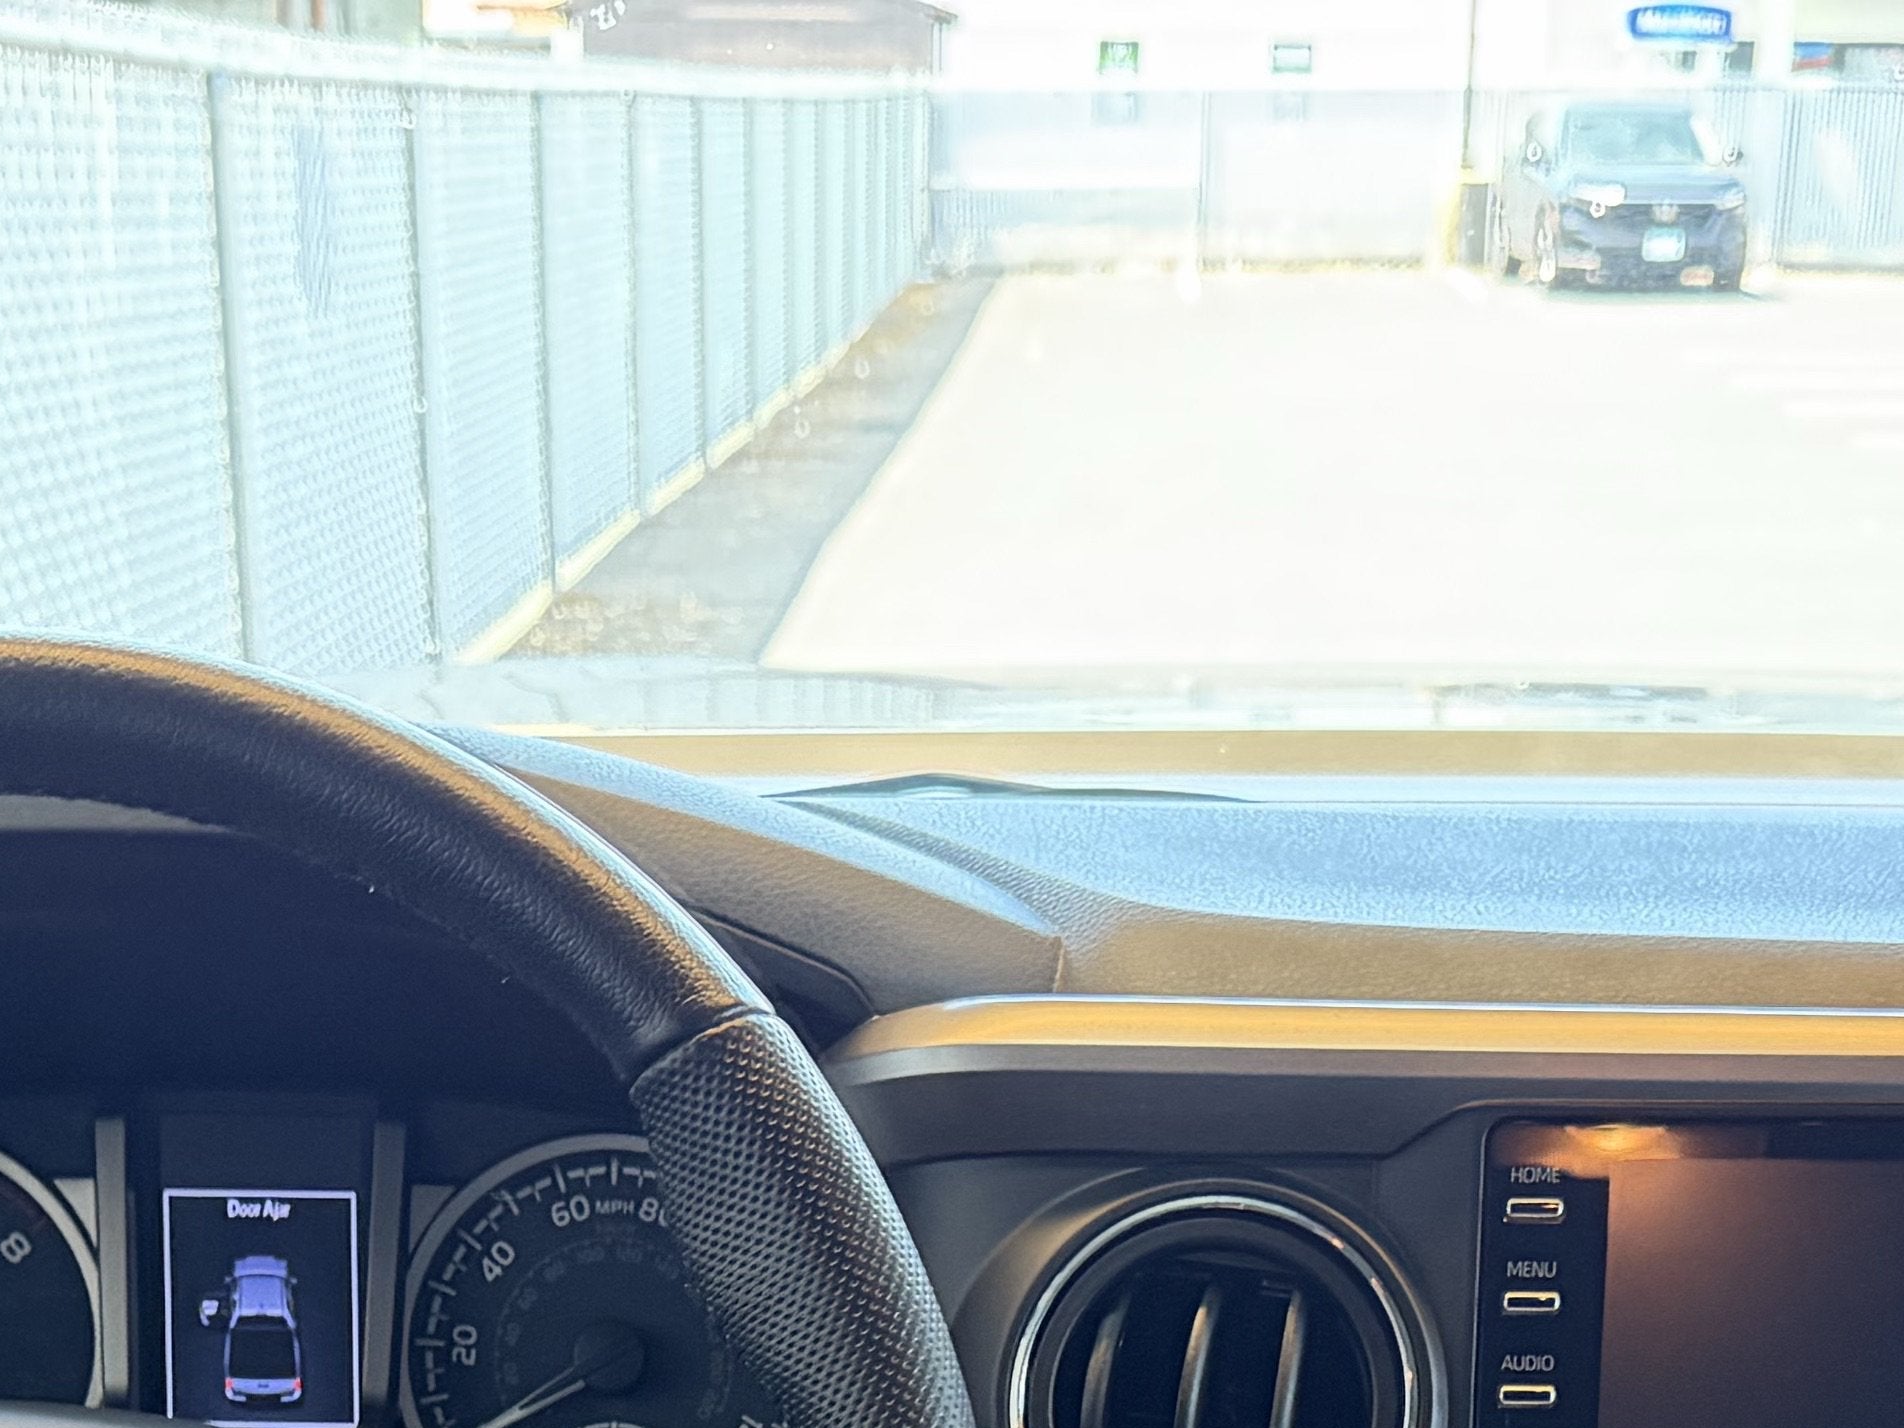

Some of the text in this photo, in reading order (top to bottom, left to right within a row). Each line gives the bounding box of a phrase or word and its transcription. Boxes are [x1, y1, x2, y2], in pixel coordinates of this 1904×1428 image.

[1510, 1167, 1561, 1183] HOME
[226, 1199, 291, 1222] Door Ajar
[551, 1194, 591, 1227] 60
[596, 1200, 635, 1215] MPH
[0, 1231, 33, 1264] 8
[482, 1240, 516, 1283] 40
[1507, 1261, 1558, 1278] MENU
[452, 1324, 478, 1367] 20
[1501, 1353, 1556, 1372] AUDIO
